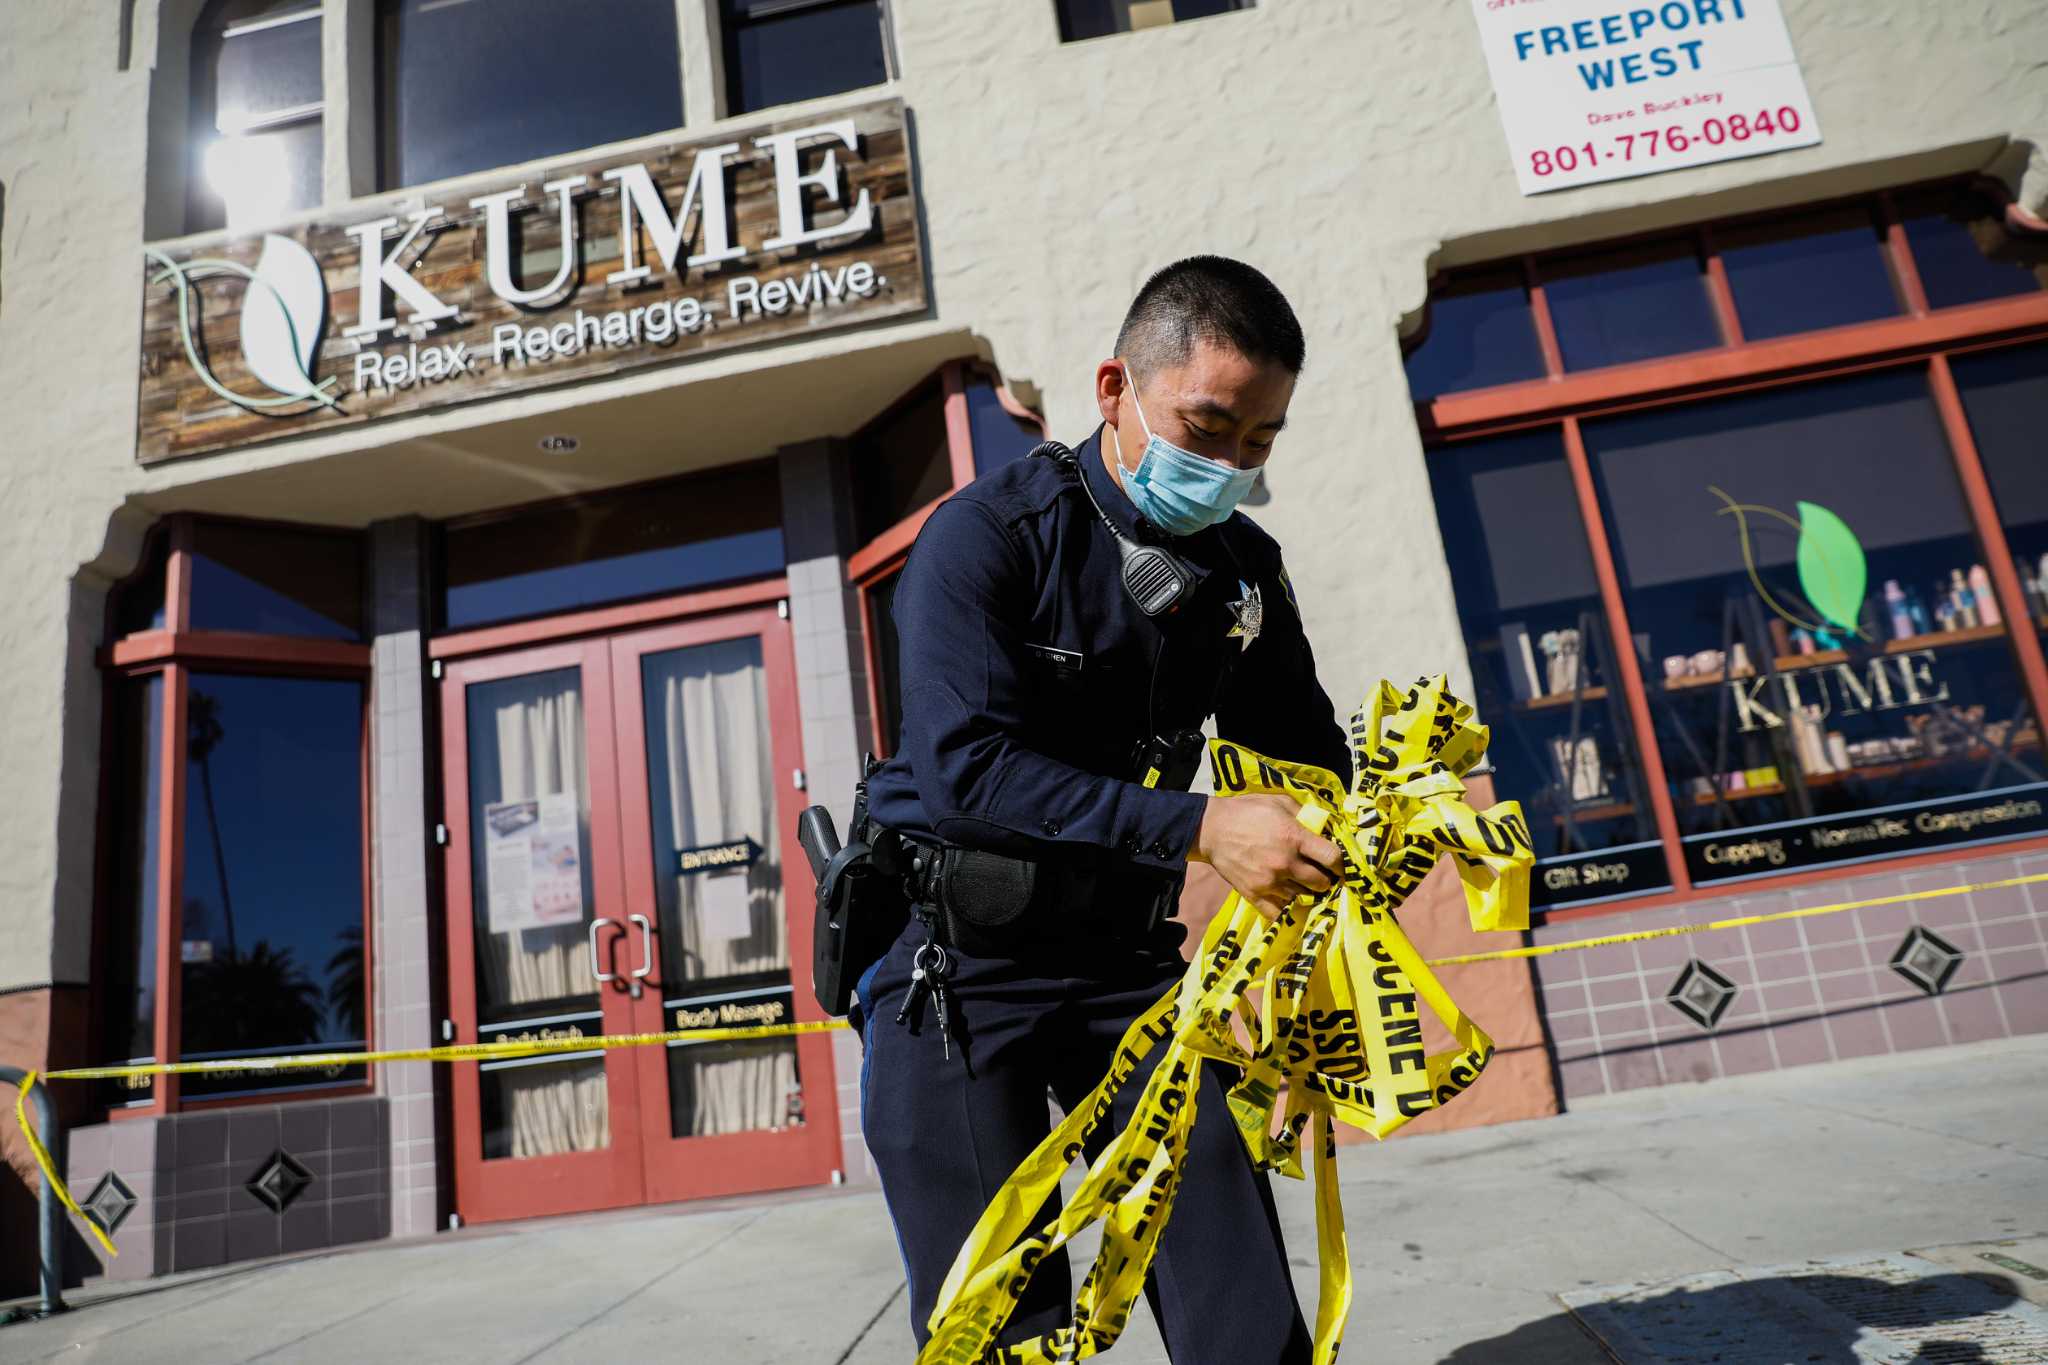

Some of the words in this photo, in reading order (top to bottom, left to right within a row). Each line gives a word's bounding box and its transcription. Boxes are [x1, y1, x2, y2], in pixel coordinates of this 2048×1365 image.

[1514, 0, 1746, 61] FREEPORT
[1579, 40, 1703, 91] WEST
[1530, 106, 1800, 177] 801-776-0840
[1587, 109, 1635, 125] Dave
[341, 118, 875, 338] KUME
[354, 341, 476, 392] Relax.
[493, 296, 712, 365] Recharge.
[728, 261, 887, 319] Revive.
[1730, 648, 1950, 733] KUME
[681, 843, 750, 869] ENTRANCE
[1703, 838, 1787, 866] Cupping
[1914, 800, 2042, 832] Compression
[1582, 862, 1629, 885] Shop
[676, 1007, 720, 1029] Body
